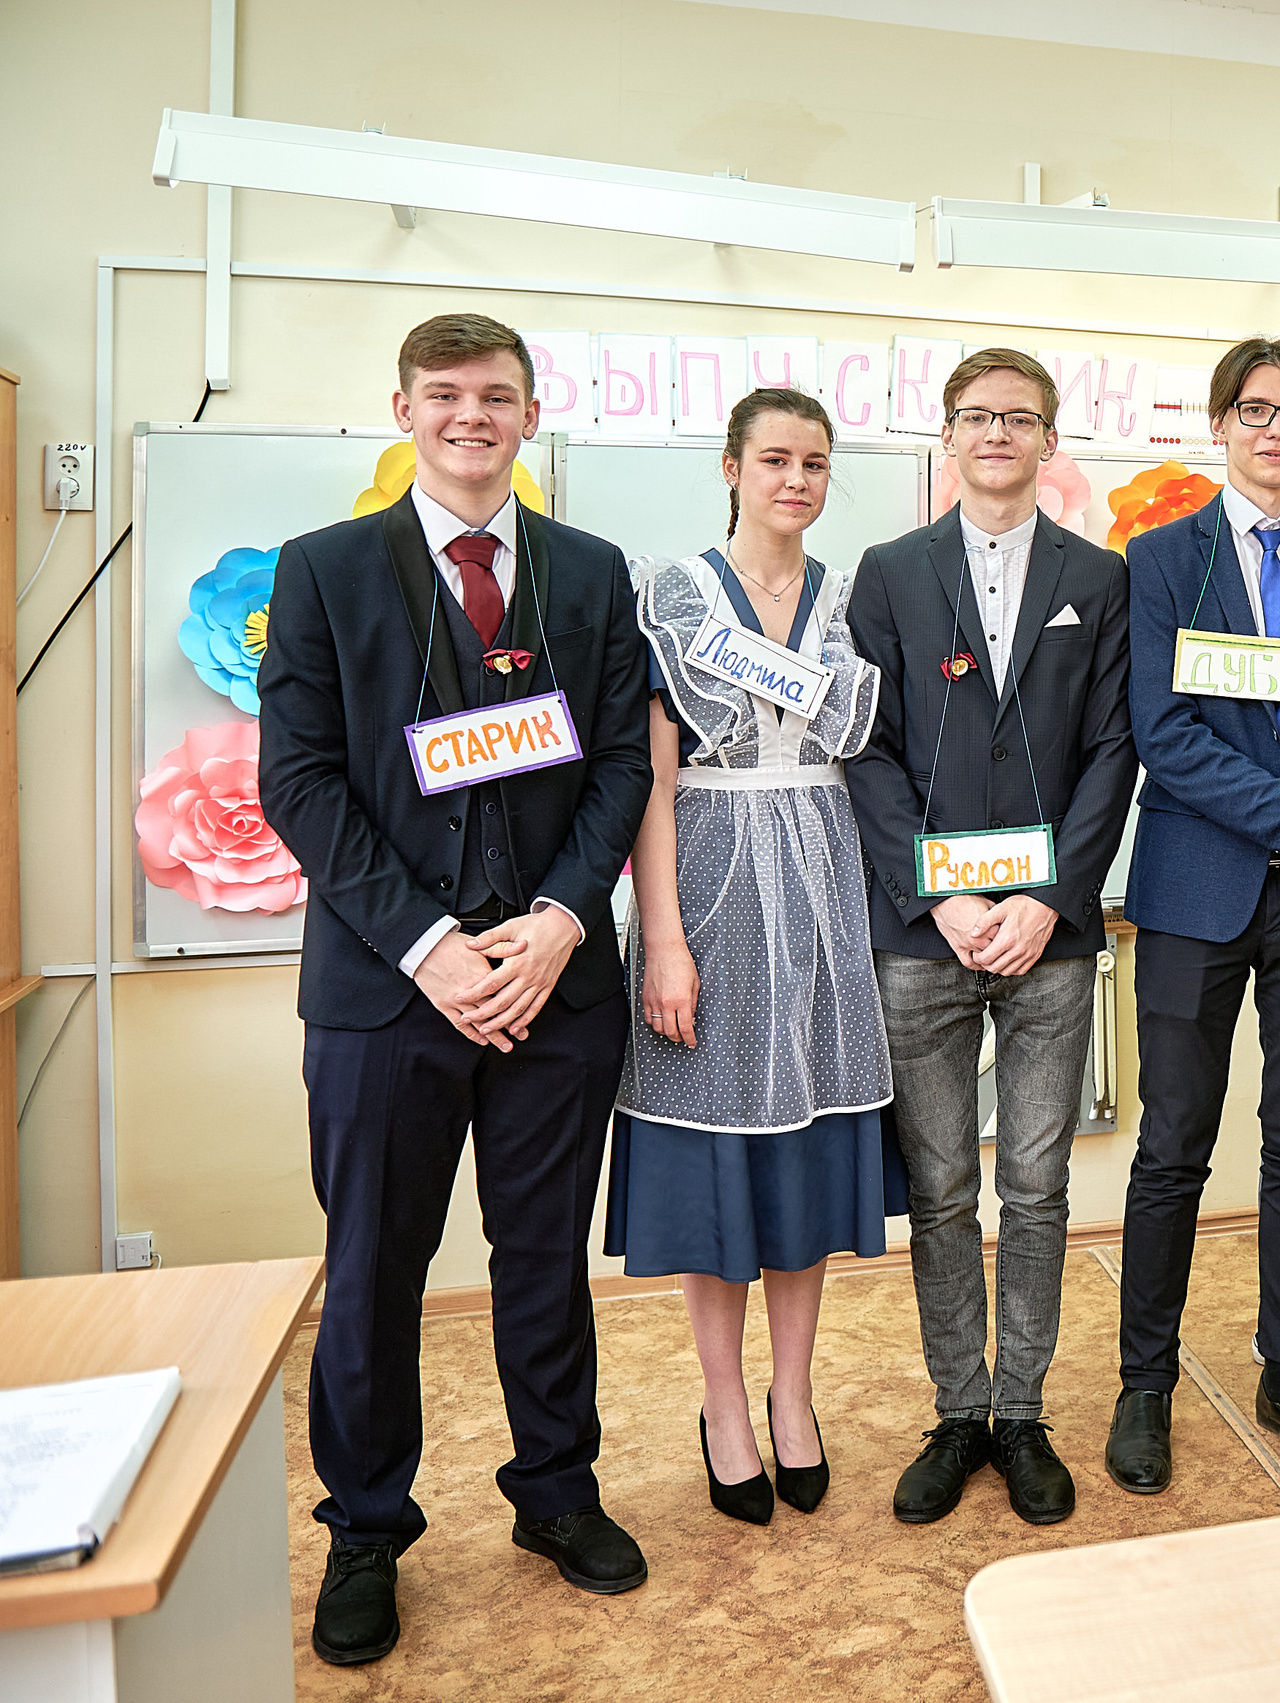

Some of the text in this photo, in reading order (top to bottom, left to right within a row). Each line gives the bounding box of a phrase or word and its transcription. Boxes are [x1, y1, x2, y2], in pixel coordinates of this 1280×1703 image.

[696, 628, 804, 703] Людмила
[1181, 652, 1278, 695] ДУБ
[425, 710, 562, 773] СТАРИК
[927, 840, 1032, 892] Руслан
